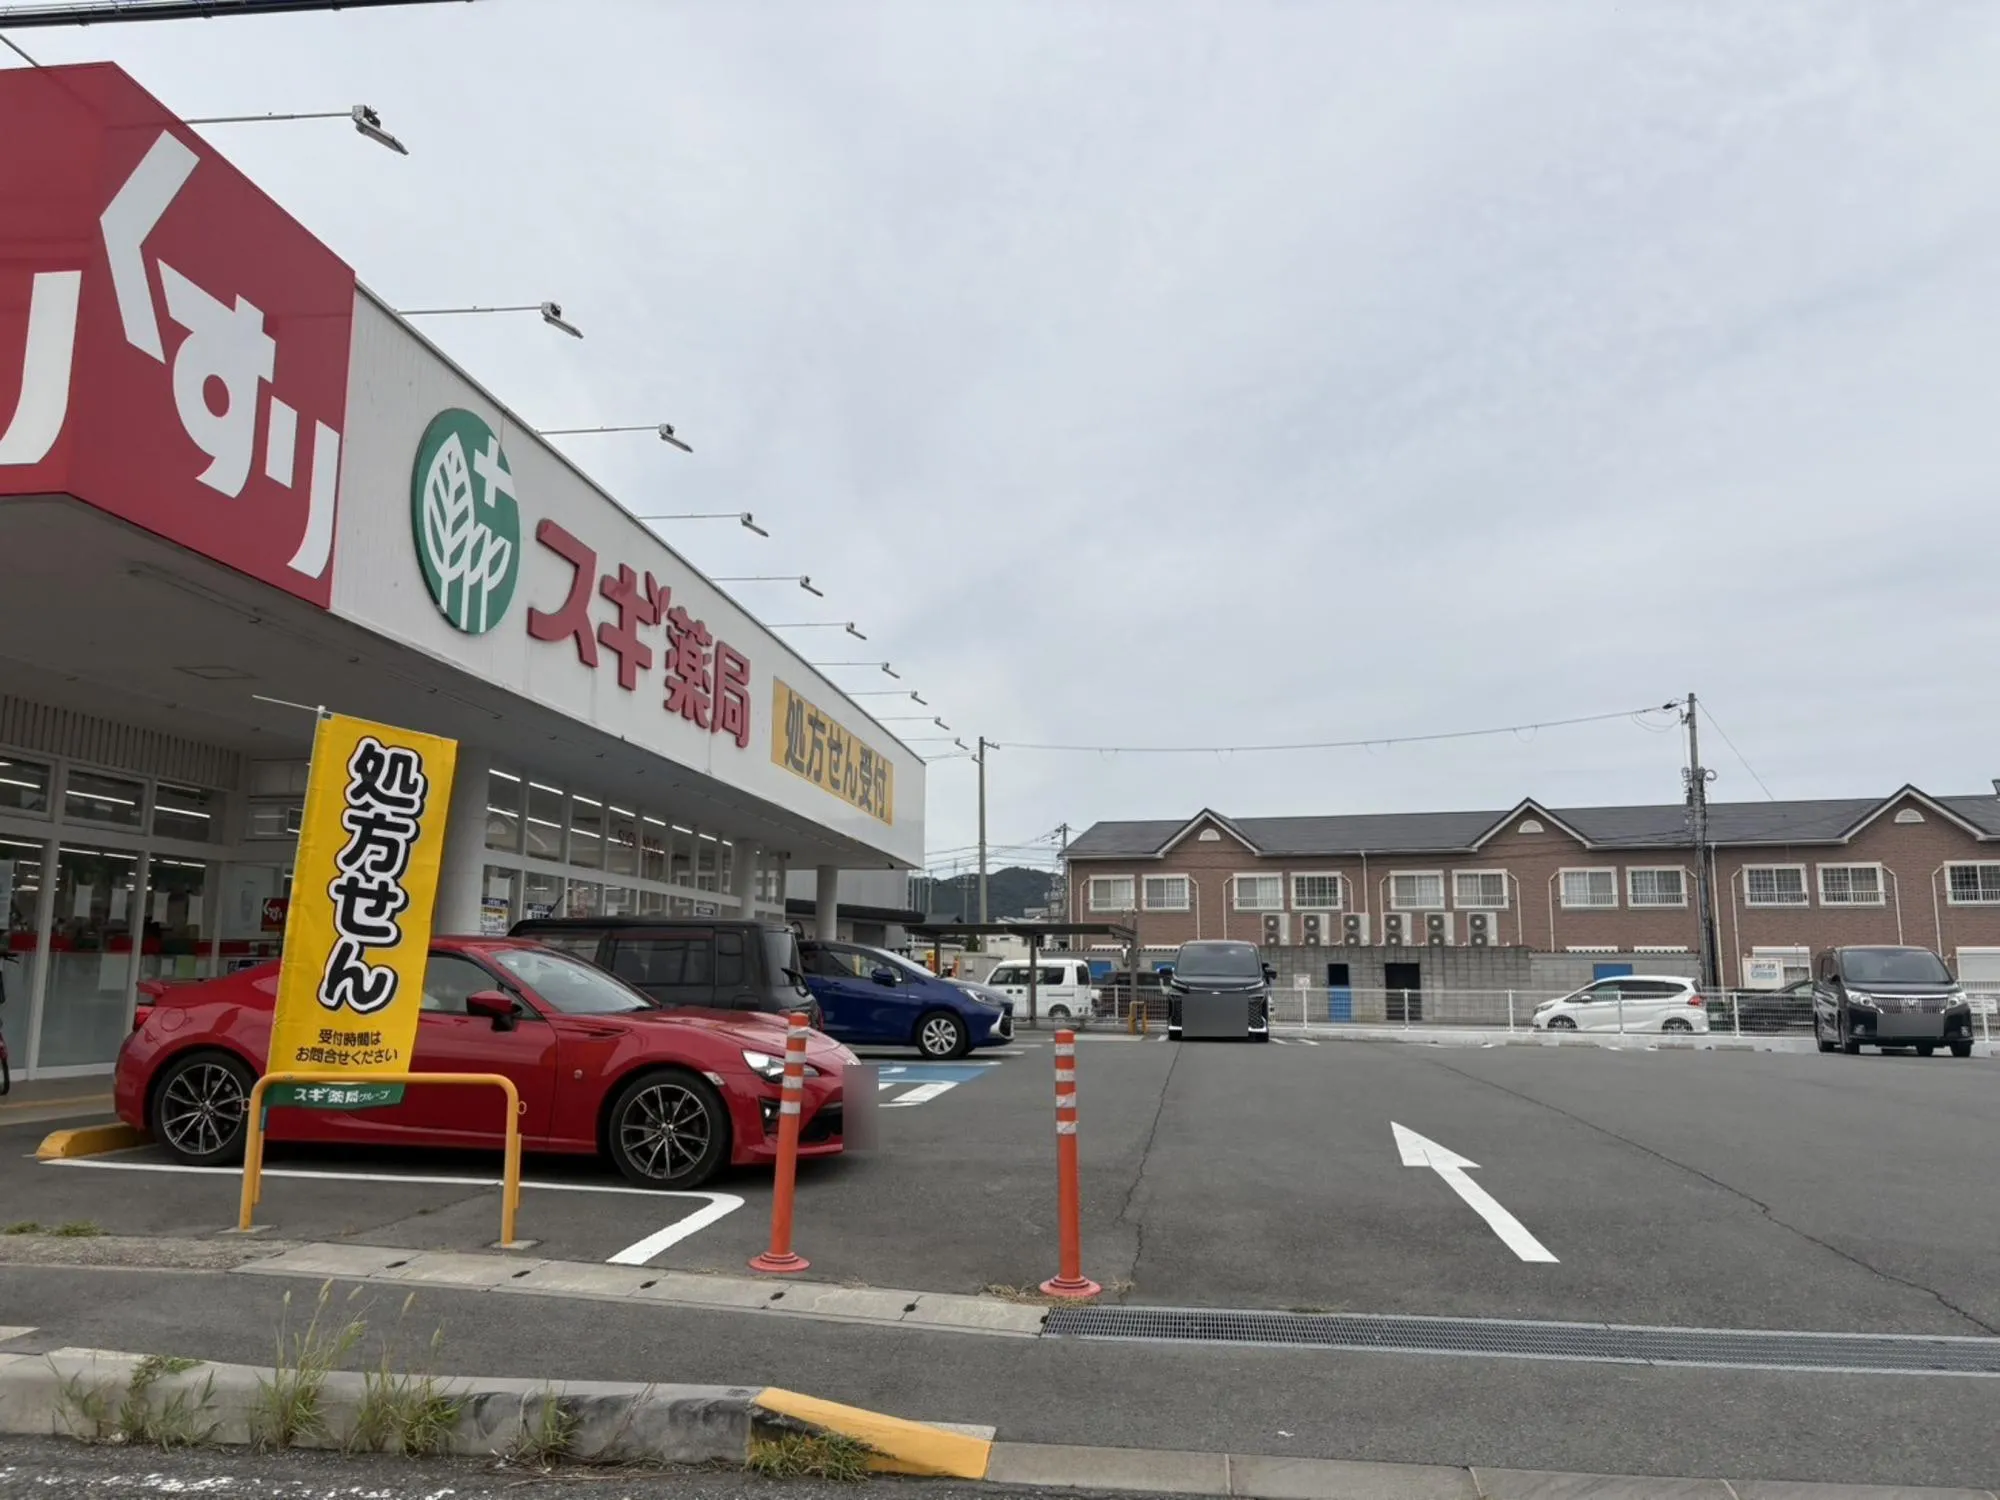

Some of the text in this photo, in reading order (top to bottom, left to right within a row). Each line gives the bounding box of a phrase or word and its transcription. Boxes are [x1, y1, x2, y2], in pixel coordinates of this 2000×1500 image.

[100, 129, 340, 579] くすり
[527, 518, 751, 749] スギ薬局
[785, 689, 887, 818] 処方せん受付
[318, 736, 428, 1014] 処方せん
[294, 1087, 391, 1104] スギ薬局グループ
[295, 1047, 398, 1066] お問合せください
[318, 1029, 382, 1047] 受付時間は
